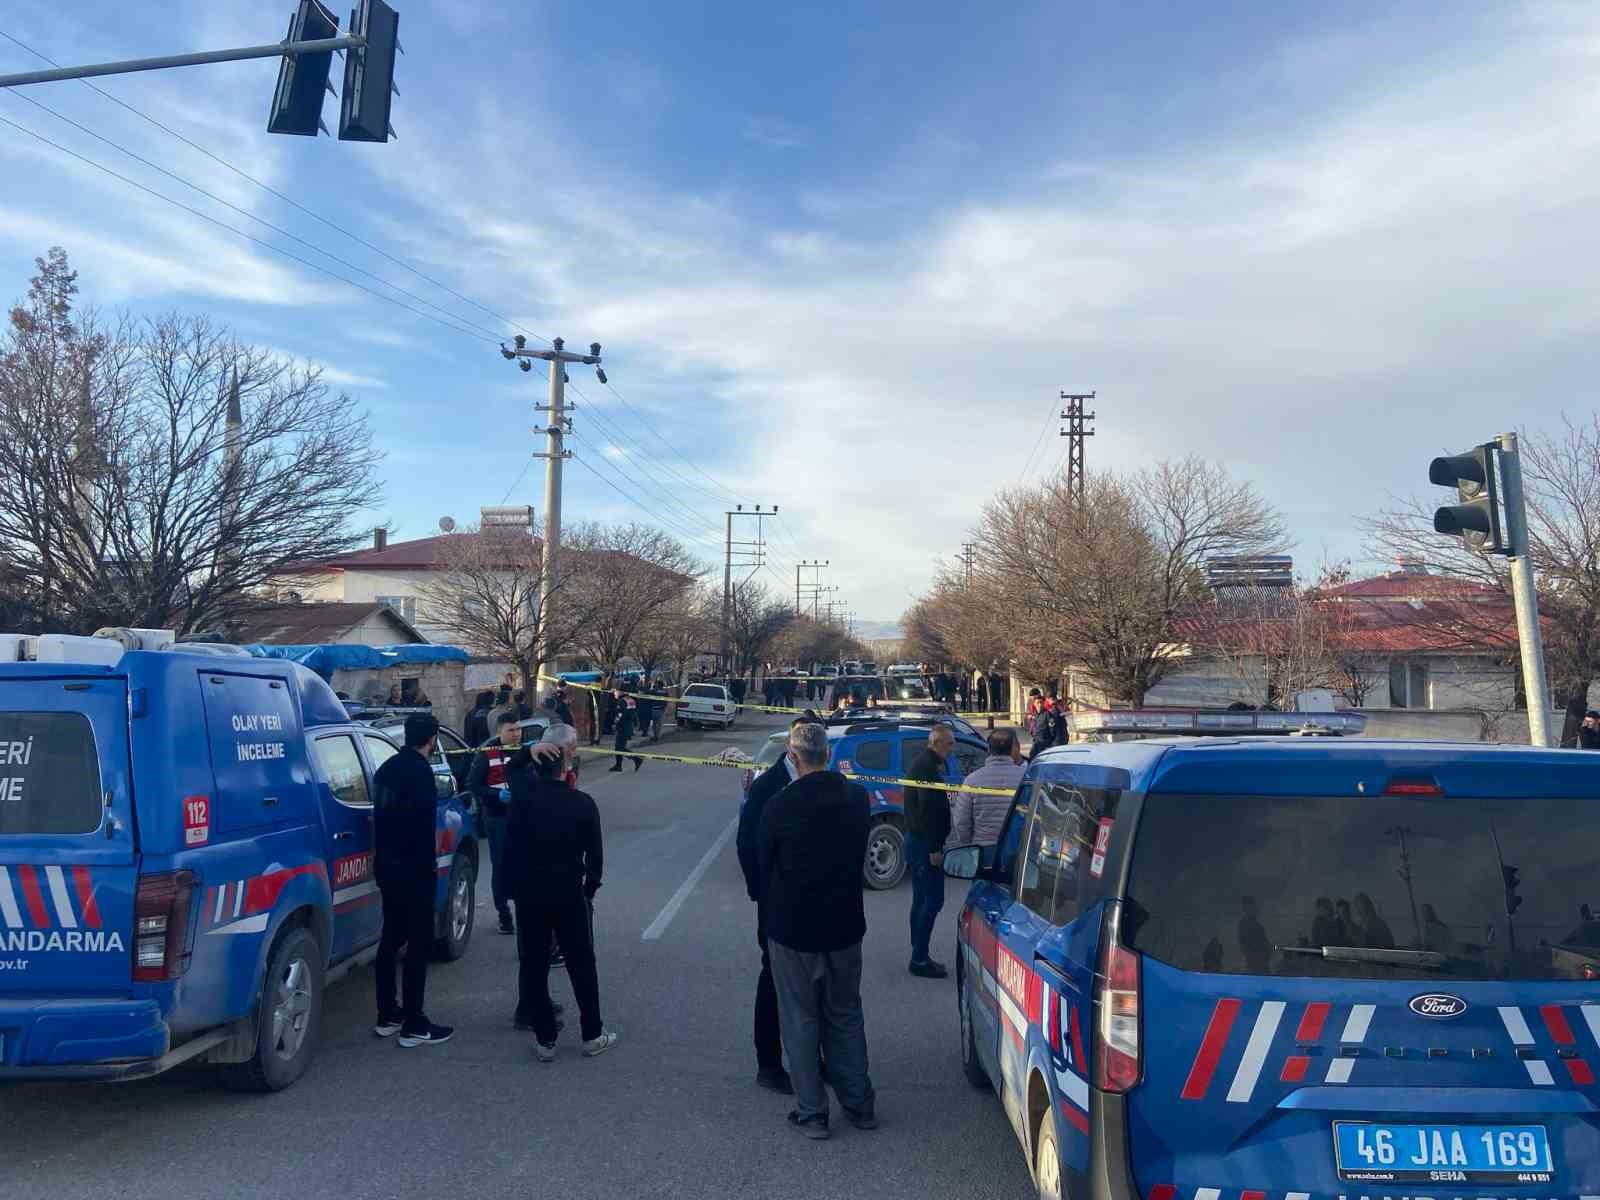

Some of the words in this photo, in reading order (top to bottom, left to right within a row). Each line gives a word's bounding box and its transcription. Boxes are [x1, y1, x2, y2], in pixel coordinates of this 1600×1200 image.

[231, 714, 258, 732] OLAY
[260, 712, 282, 731] YERİ
[236, 741, 286, 761] İNCELEME
[187, 800, 206, 825] 112
[1422, 997, 1456, 1013] Ford
[1356, 1128, 1395, 1165] 46
[1411, 1129, 1468, 1166] JAA
[1480, 1130, 1538, 1168] 169
[1430, 1170, 1467, 1182] SEHA
